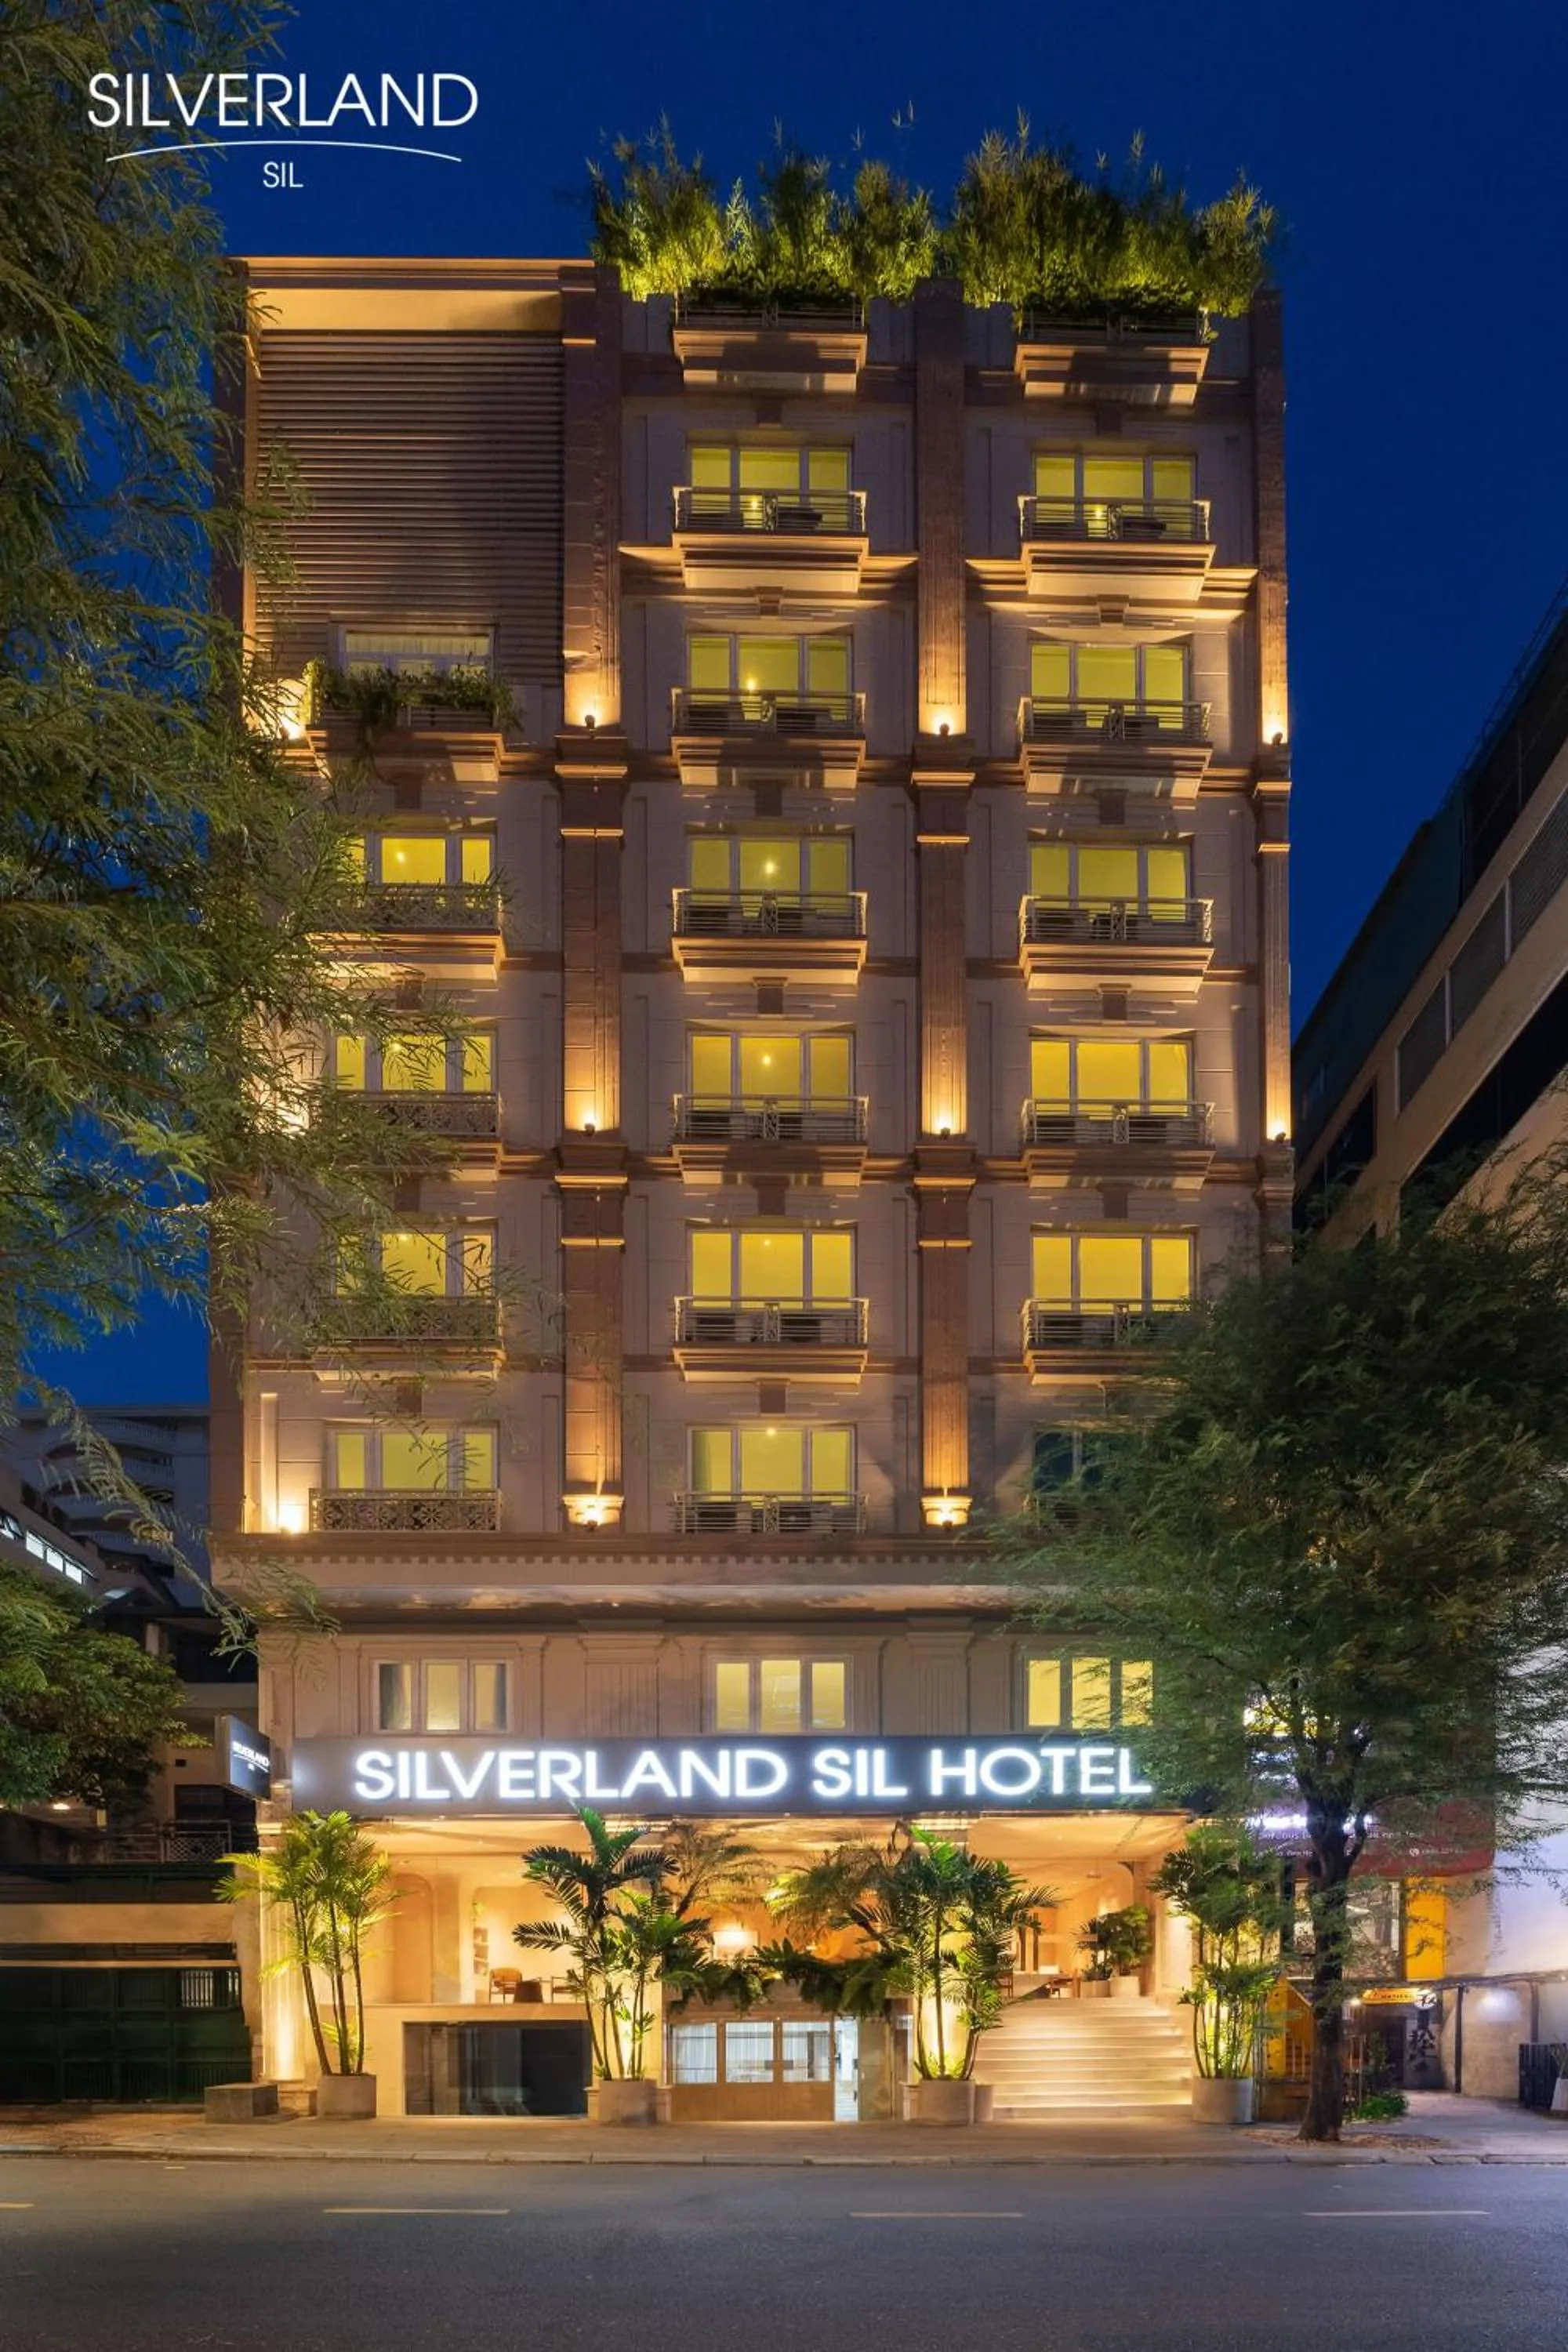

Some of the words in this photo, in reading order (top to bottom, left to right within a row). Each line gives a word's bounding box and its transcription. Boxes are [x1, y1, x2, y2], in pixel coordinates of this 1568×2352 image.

[232, 1741, 270, 1766] ERLAND
[353, 1748, 789, 1800] SILVERLAND
[811, 1748, 909, 1798] SIL
[930, 1747, 1153, 1797] HOTEL
